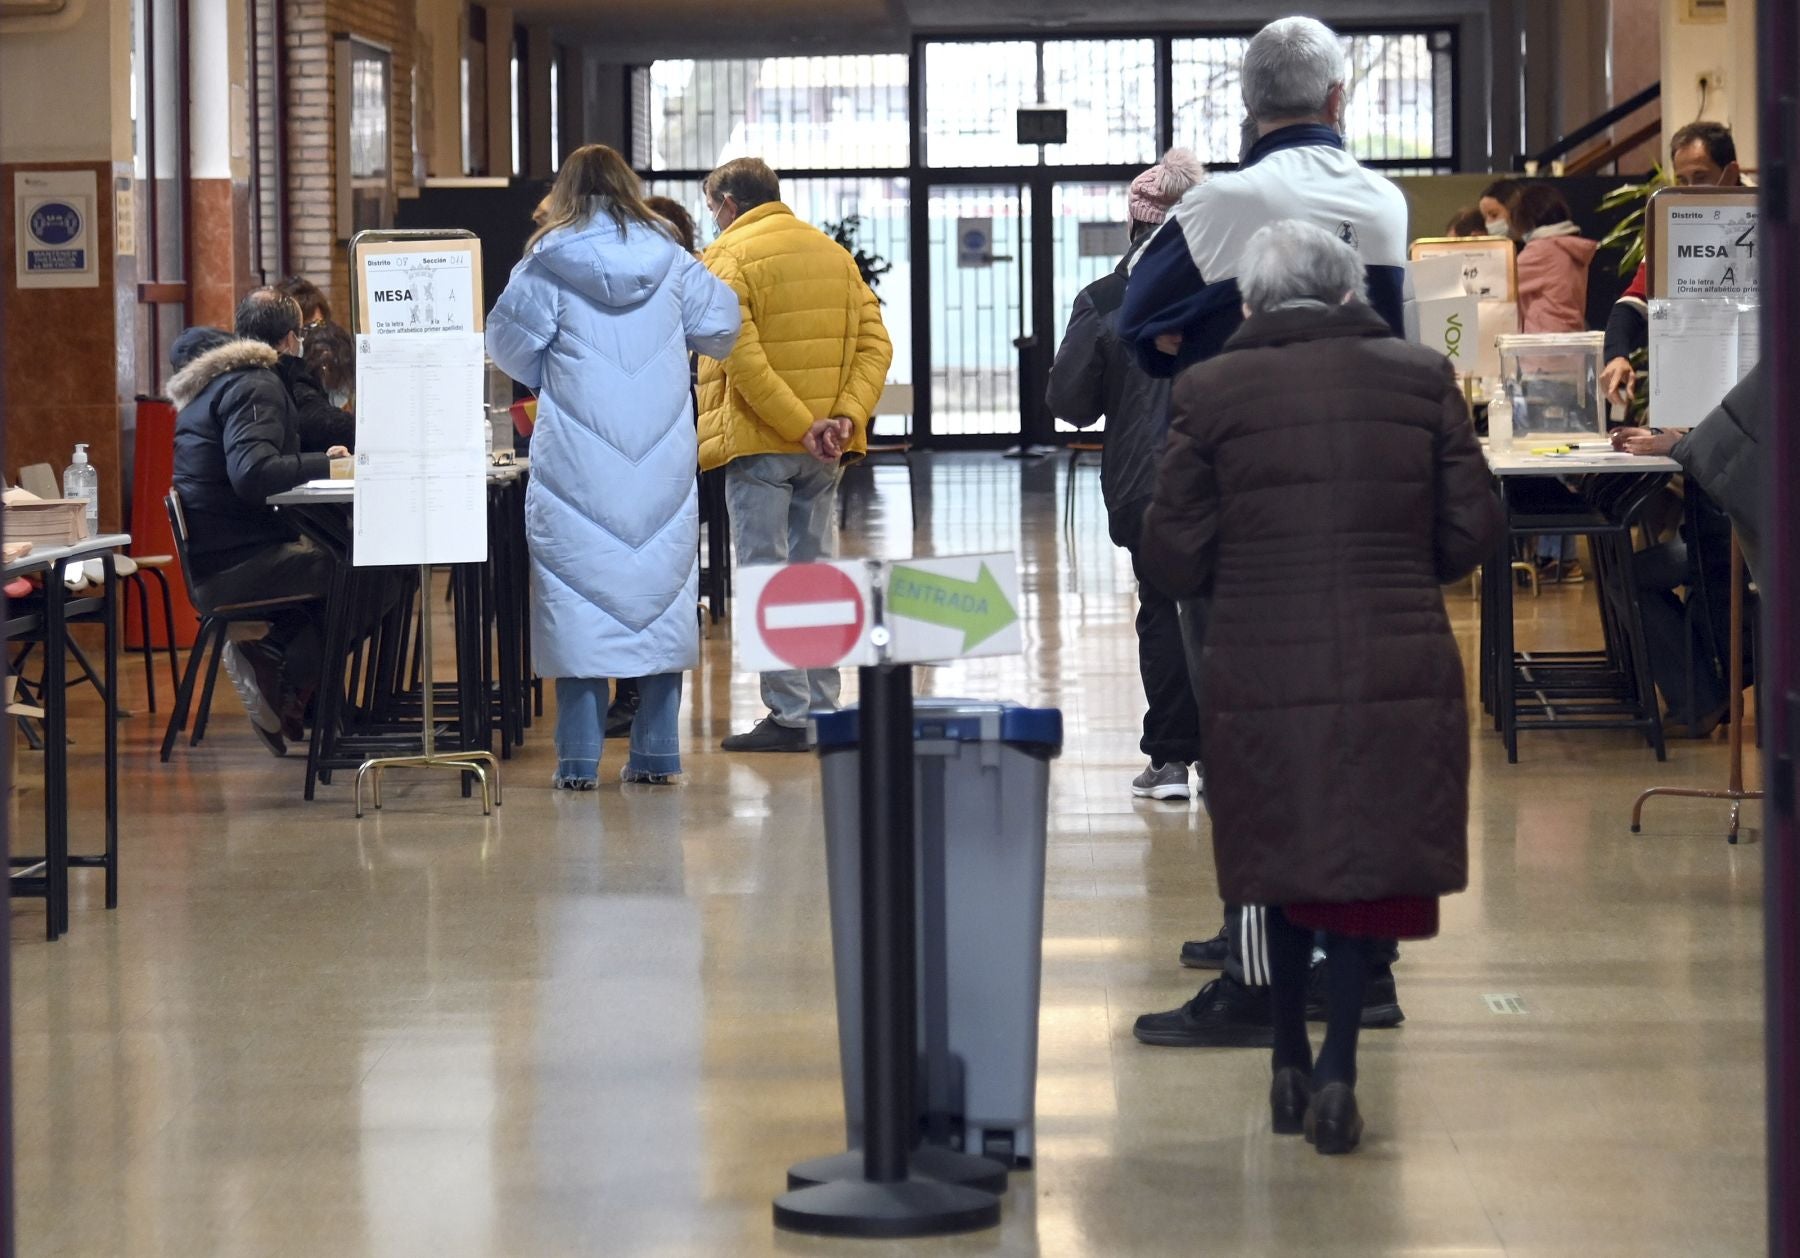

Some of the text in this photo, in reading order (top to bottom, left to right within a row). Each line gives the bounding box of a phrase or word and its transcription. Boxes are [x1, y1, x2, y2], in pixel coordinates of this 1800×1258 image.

[1714, 210, 1721, 220] 8
[1677, 225, 1755, 258] MESA 4
[1720, 267, 1735, 286] A
[374, 289, 413, 302] MESA
[377, 327, 396, 335] (Orden
[397, 326, 423, 334] alfabético
[1445, 313, 1463, 357] VOX
[894, 577, 989, 615] ENTRADA
